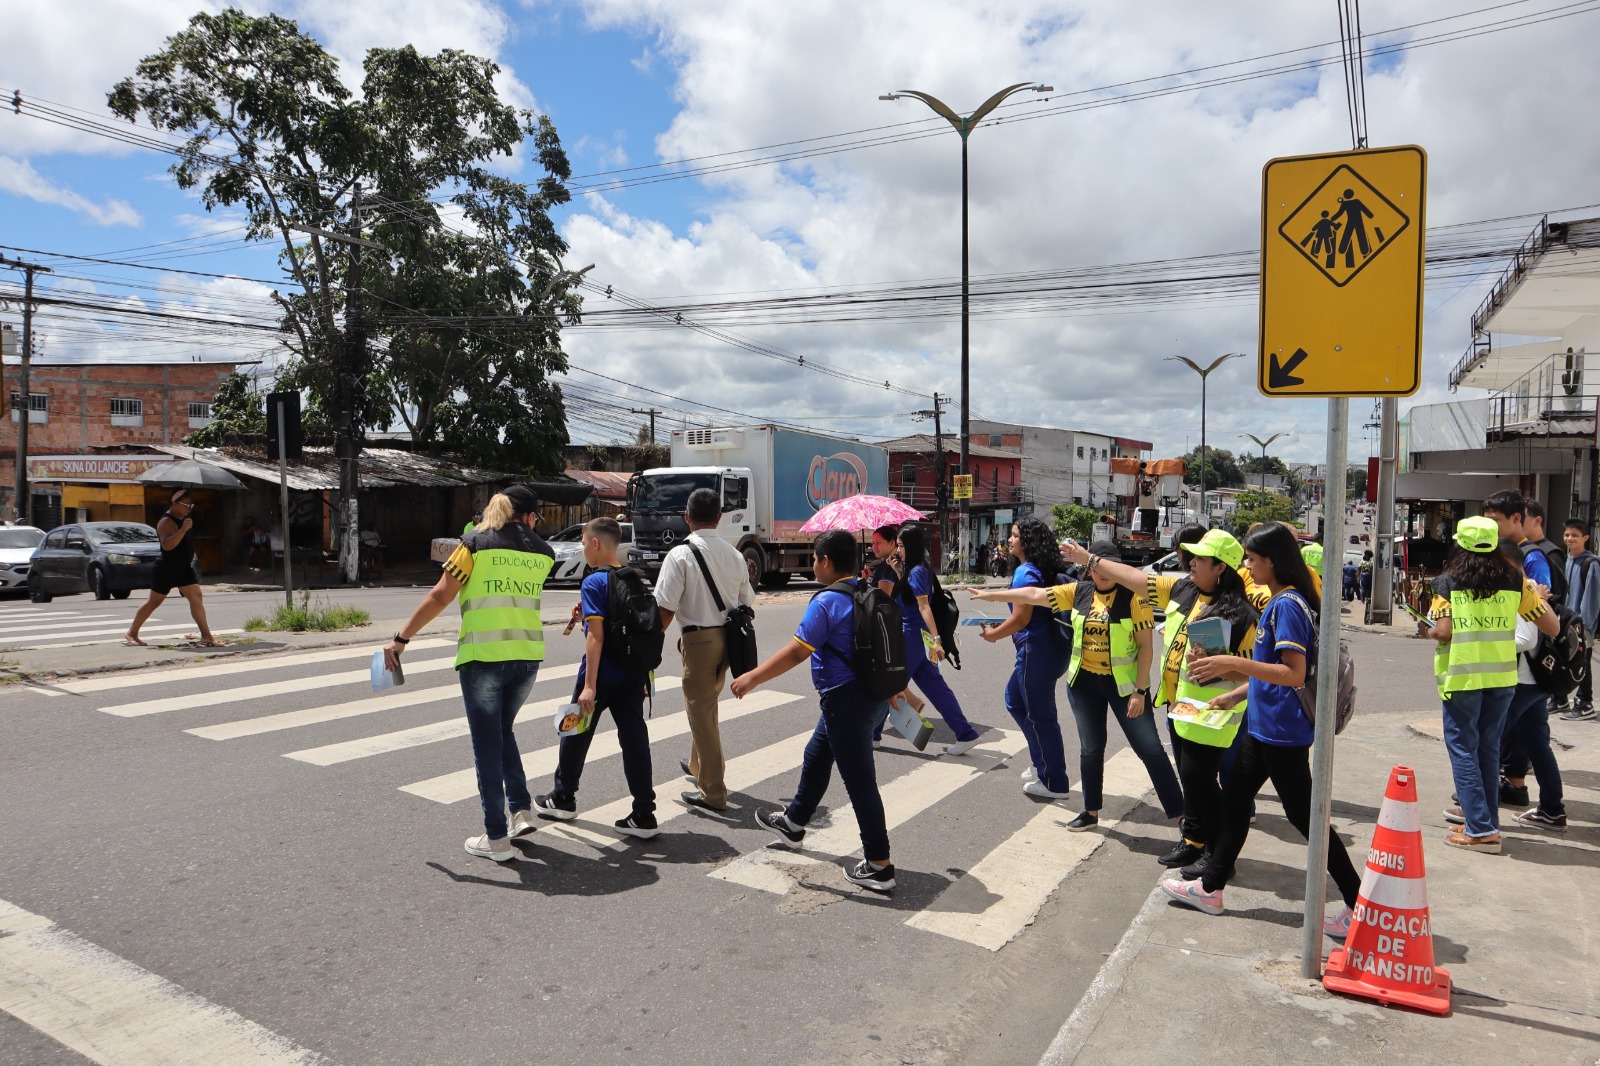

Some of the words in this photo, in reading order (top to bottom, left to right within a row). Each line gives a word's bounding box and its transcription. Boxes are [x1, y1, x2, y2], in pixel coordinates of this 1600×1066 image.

[63, 461, 84, 473] SKINA
[86, 461, 97, 473] DO
[98, 461, 130, 474] LANCHE
[808, 454, 858, 501] Clara
[492, 556, 545, 570] EDUCAÇÃO
[483, 577, 542, 596] TRÂNSIT
[1368, 848, 1405, 871] anaus
[1377, 934, 1406, 957] DE
[1346, 947, 1432, 985] TRÂNSITO
